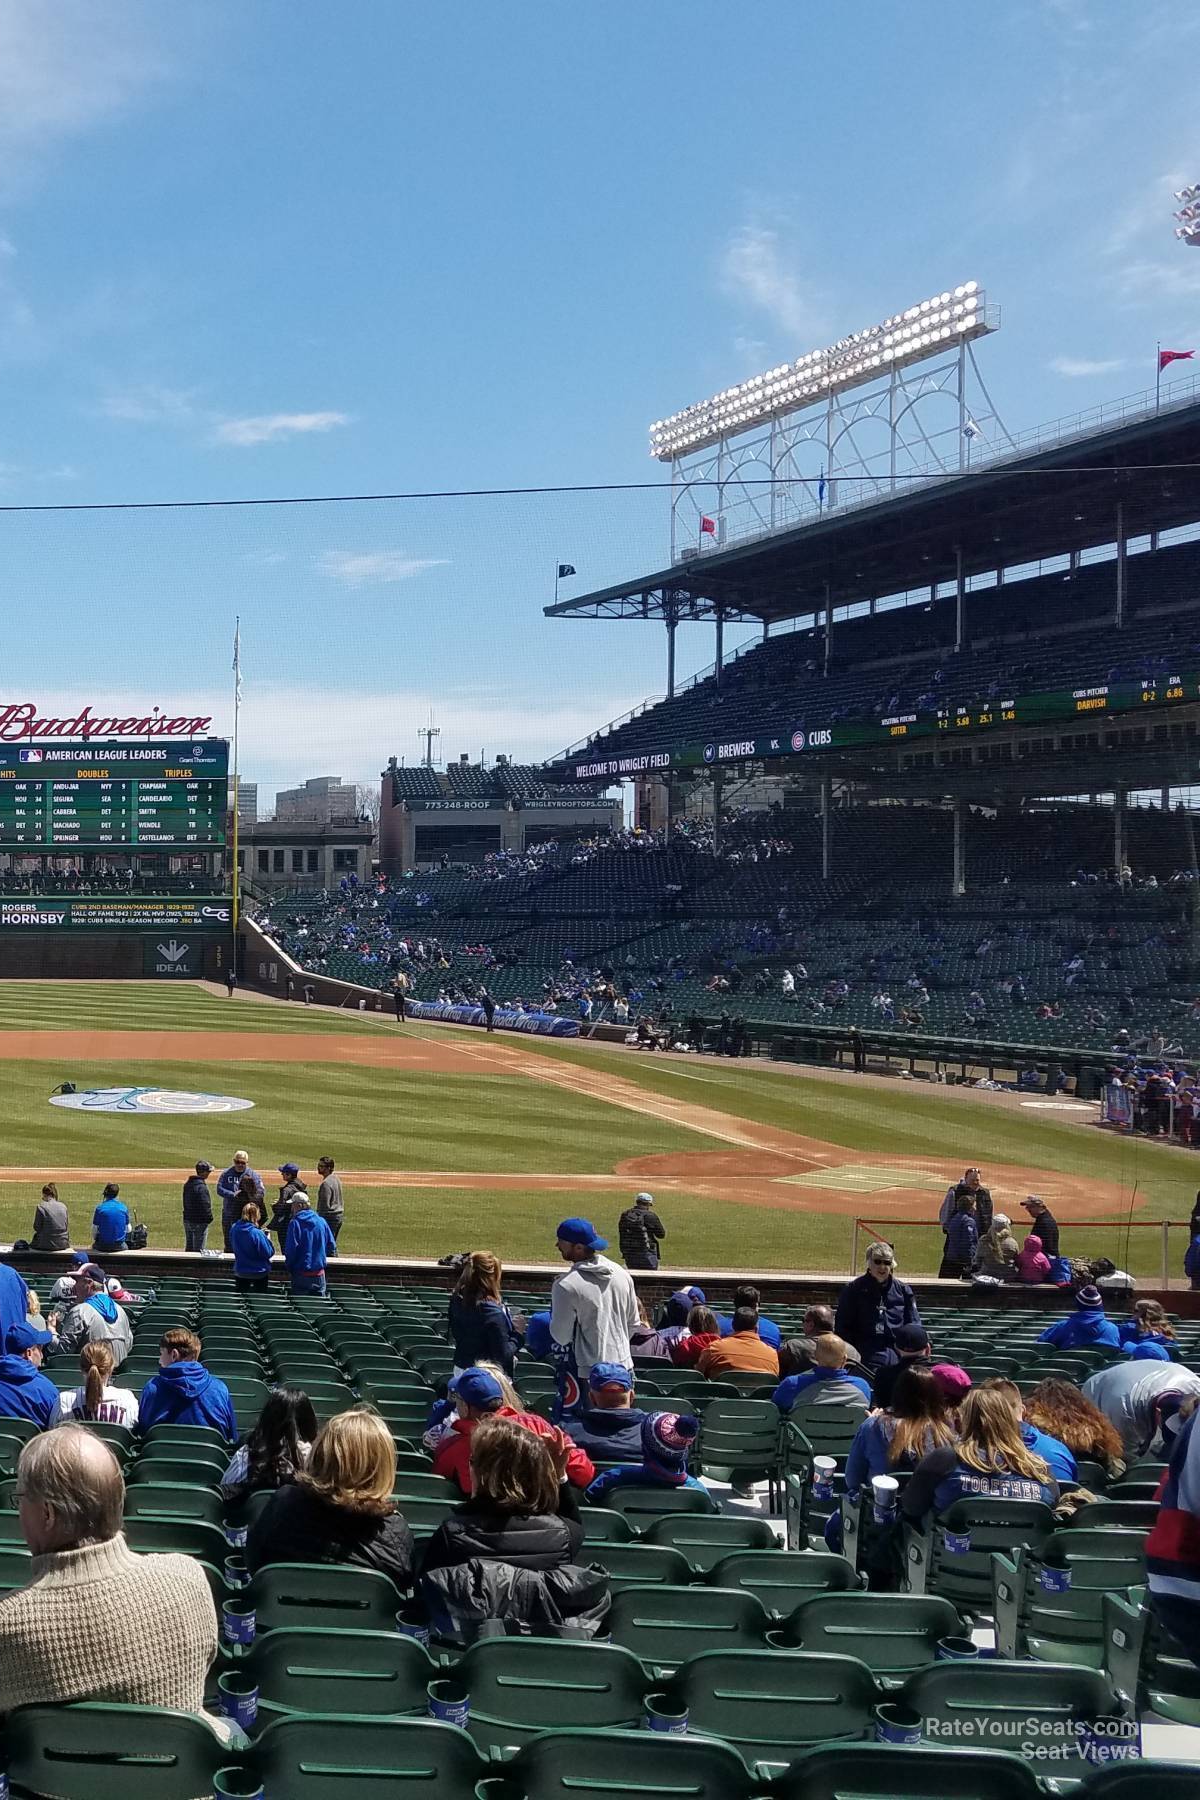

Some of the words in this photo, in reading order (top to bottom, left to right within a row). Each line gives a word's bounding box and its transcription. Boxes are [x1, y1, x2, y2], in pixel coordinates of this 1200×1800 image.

[1169, 676, 1181, 685] ERA
[1077, 699, 1106, 710] DARVISH
[890, 725, 907, 736] SUTER
[718, 740, 755, 758] BREWERS
[809, 730, 832, 746] CUBS
[46, 750, 92, 760] AMERICAN
[95, 750, 127, 760] LEAGUE
[130, 750, 167, 759] LEADERS
[576, 762, 607, 778] WELCOME
[608, 760, 617, 774] TO
[619, 755, 648, 773] WRIGLEY
[650, 753, 670, 768] FIELD
[0, 770, 16, 778] HITS
[77, 770, 109, 778] DOUBLES
[164, 769, 192, 777] TRIPLES
[424, 802, 490, 810] 773-248-ROOF
[524, 800, 614, 808] WRIGLEYROOFTOPS.COM
[2, 914, 65, 924] HORNSBY
[156, 964, 190, 972] IDEAL
[412, 1003, 442, 1018] Reynolds
[442, 1006, 462, 1020] Wrap
[478, 1012, 516, 1027] Renolds
[515, 1015, 539, 1032] Wrap
[960, 1475, 1041, 1500] TOGETHER
